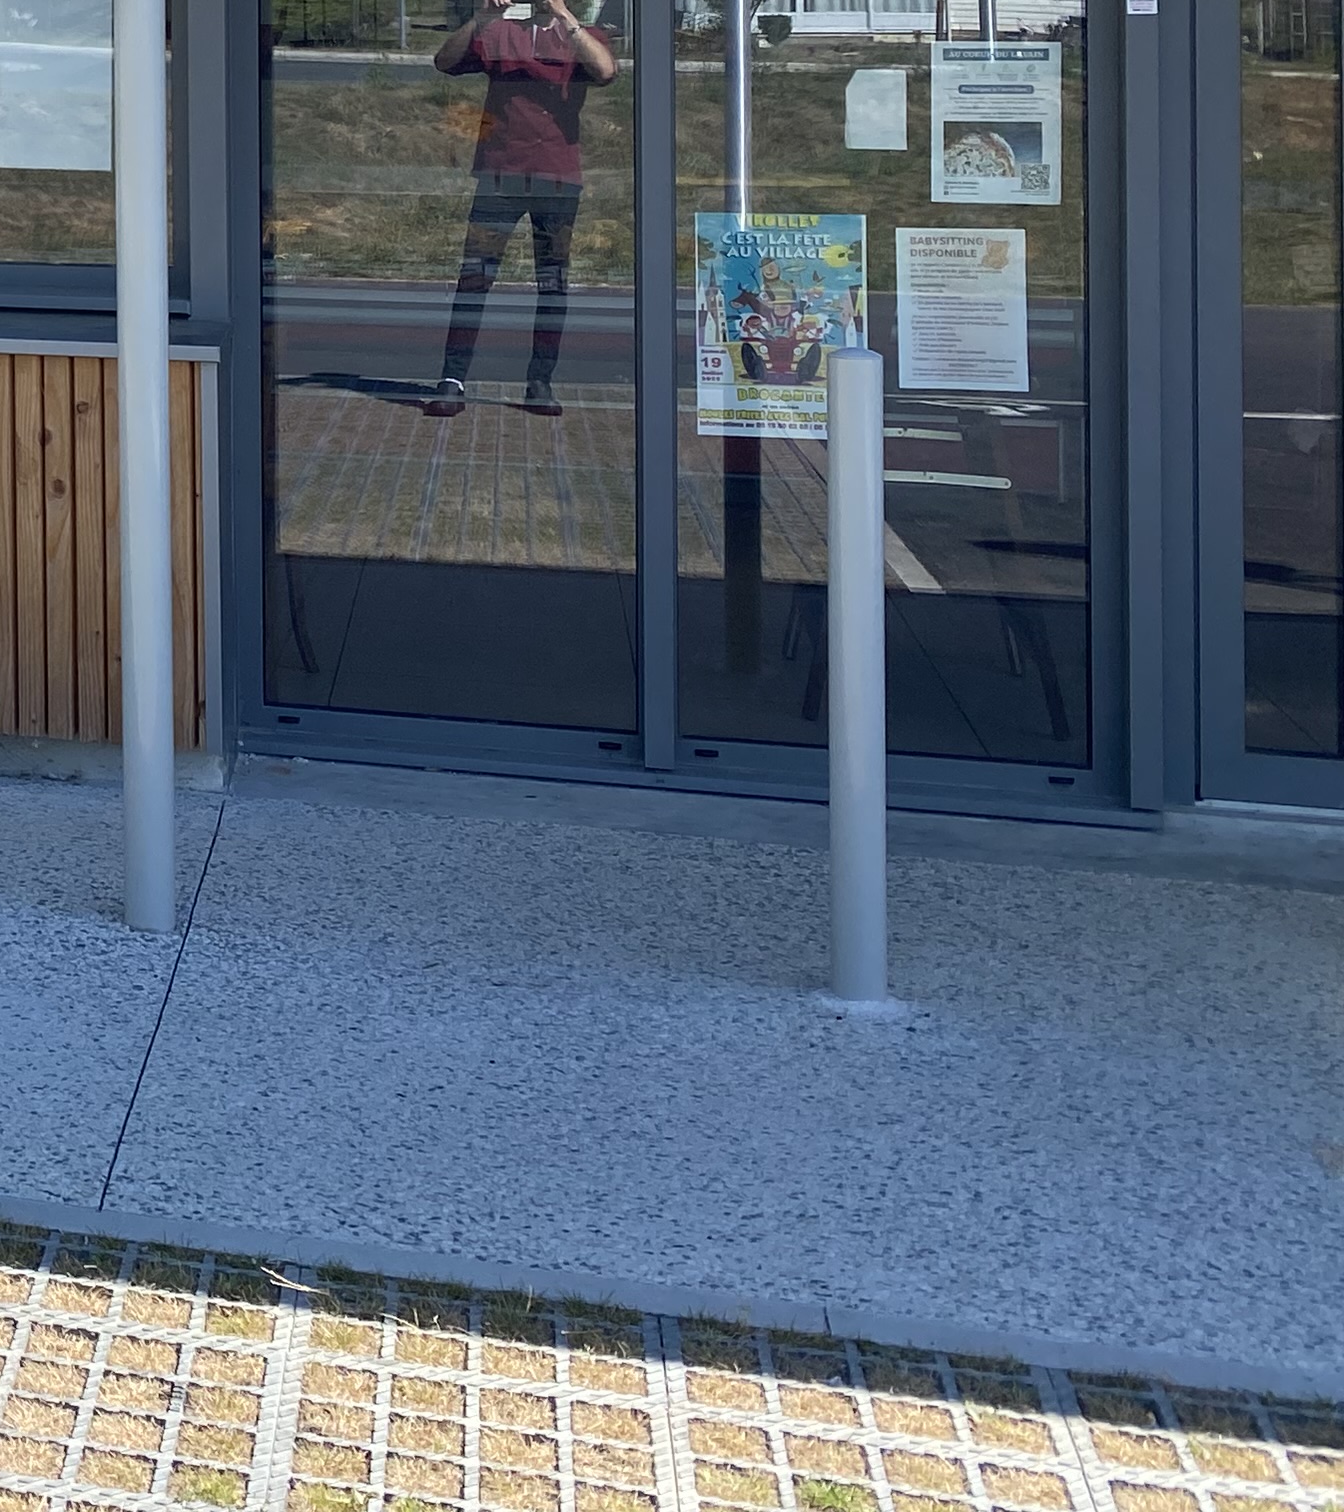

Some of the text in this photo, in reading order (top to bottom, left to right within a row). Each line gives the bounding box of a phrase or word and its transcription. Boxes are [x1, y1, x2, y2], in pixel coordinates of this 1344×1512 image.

[721, 231, 832, 246] C'EST LA FÊTE
[909, 236, 984, 245] BABYSITTING
[726, 246, 826, 259] AU VILLAGE
[909, 249, 977, 258] DISPONIBLE
[700, 357, 722, 368] 19
[736, 387, 826, 403] BROCANTE
